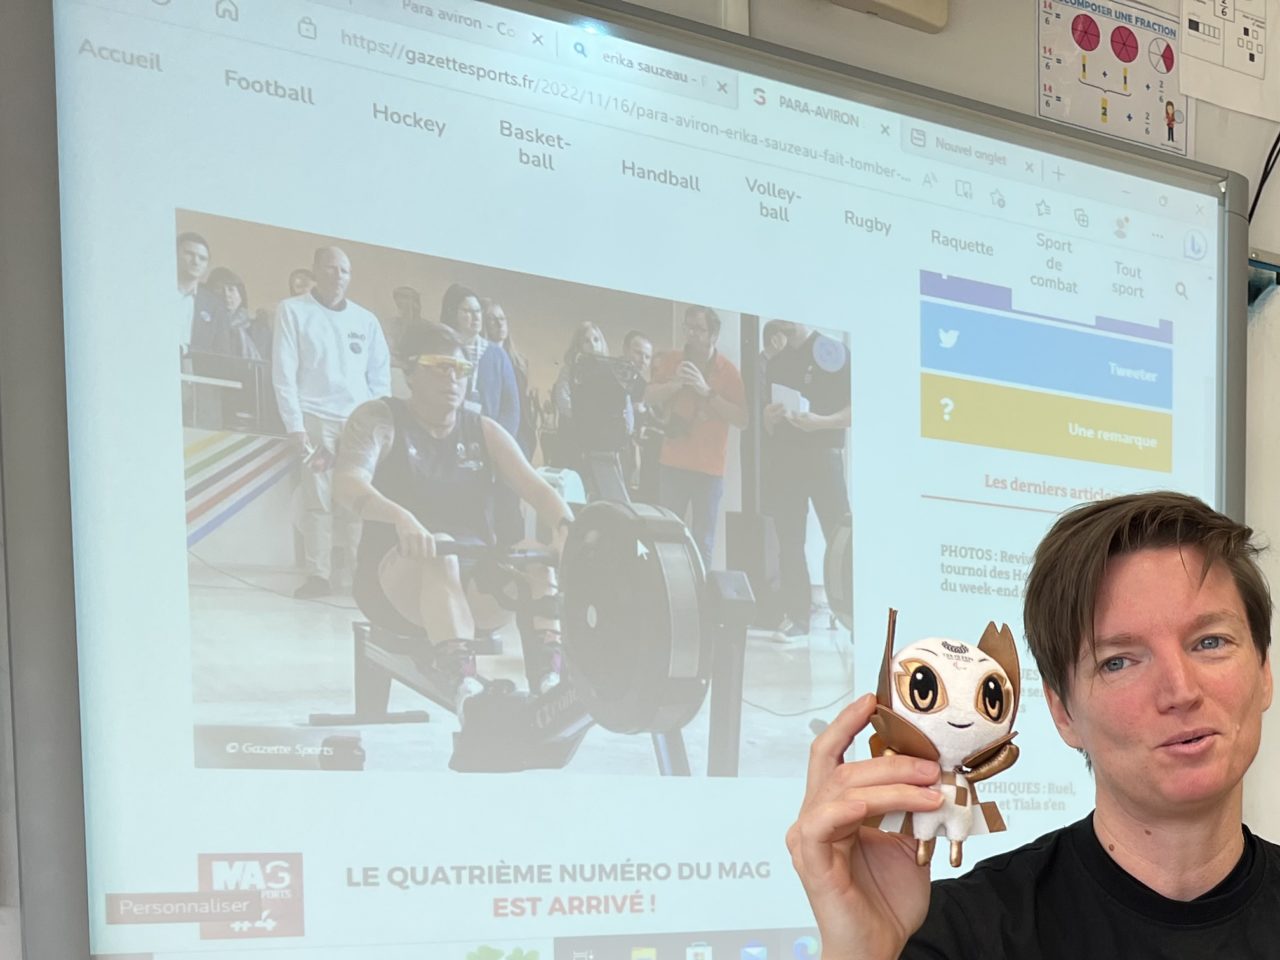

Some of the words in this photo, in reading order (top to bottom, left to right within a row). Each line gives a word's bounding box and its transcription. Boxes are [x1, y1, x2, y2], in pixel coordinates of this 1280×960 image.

[438, 9, 482, 30] aviron
[1115, 10, 1132, 23] UNE
[1135, 14, 1177, 38] FRACTION
[78, 38, 163, 73] Accueil
[637, 61, 688, 84] sauzeau
[224, 69, 315, 105] Football
[372, 102, 446, 136] Hockey
[779, 96, 859, 128] PARA-AVIRON
[499, 120, 572, 150] Basket-
[519, 148, 555, 171] ball
[621, 160, 700, 192] Handball
[745, 177, 802, 204] Volley-
[759, 202, 790, 222] ball
[844, 210, 892, 237] Rugby
[930, 229, 994, 257] Raquette
[1036, 233, 1072, 254] Sport
[1046, 257, 1063, 271] de
[1114, 260, 1142, 280] Tout
[1030, 271, 1078, 294] combat
[1112, 279, 1144, 300] sport
[1108, 361, 1158, 383] Tweeter
[1068, 422, 1095, 440] Une
[1097, 429, 1158, 450] remarque
[984, 474, 1008, 490] Les
[1010, 478, 1068, 498] derniers
[941, 543, 993, 561] PHOTOS
[941, 561, 987, 578] tournoi
[989, 565, 1010, 580] des
[941, 579, 958, 593] du
[960, 581, 1019, 599] week-end
[242, 742, 291, 755] Gazette
[294, 744, 334, 757] Sports
[346, 866, 379, 887] LE
[387, 859, 552, 890] QUATRIÈME
[559, 858, 672, 883] NUMÉRO
[677, 861, 711, 881] DU
[717, 861, 771, 880] MAG
[119, 898, 250, 916] Personnaliser
[493, 896, 542, 918] EST
[547, 889, 645, 916] ARRIVÉ
